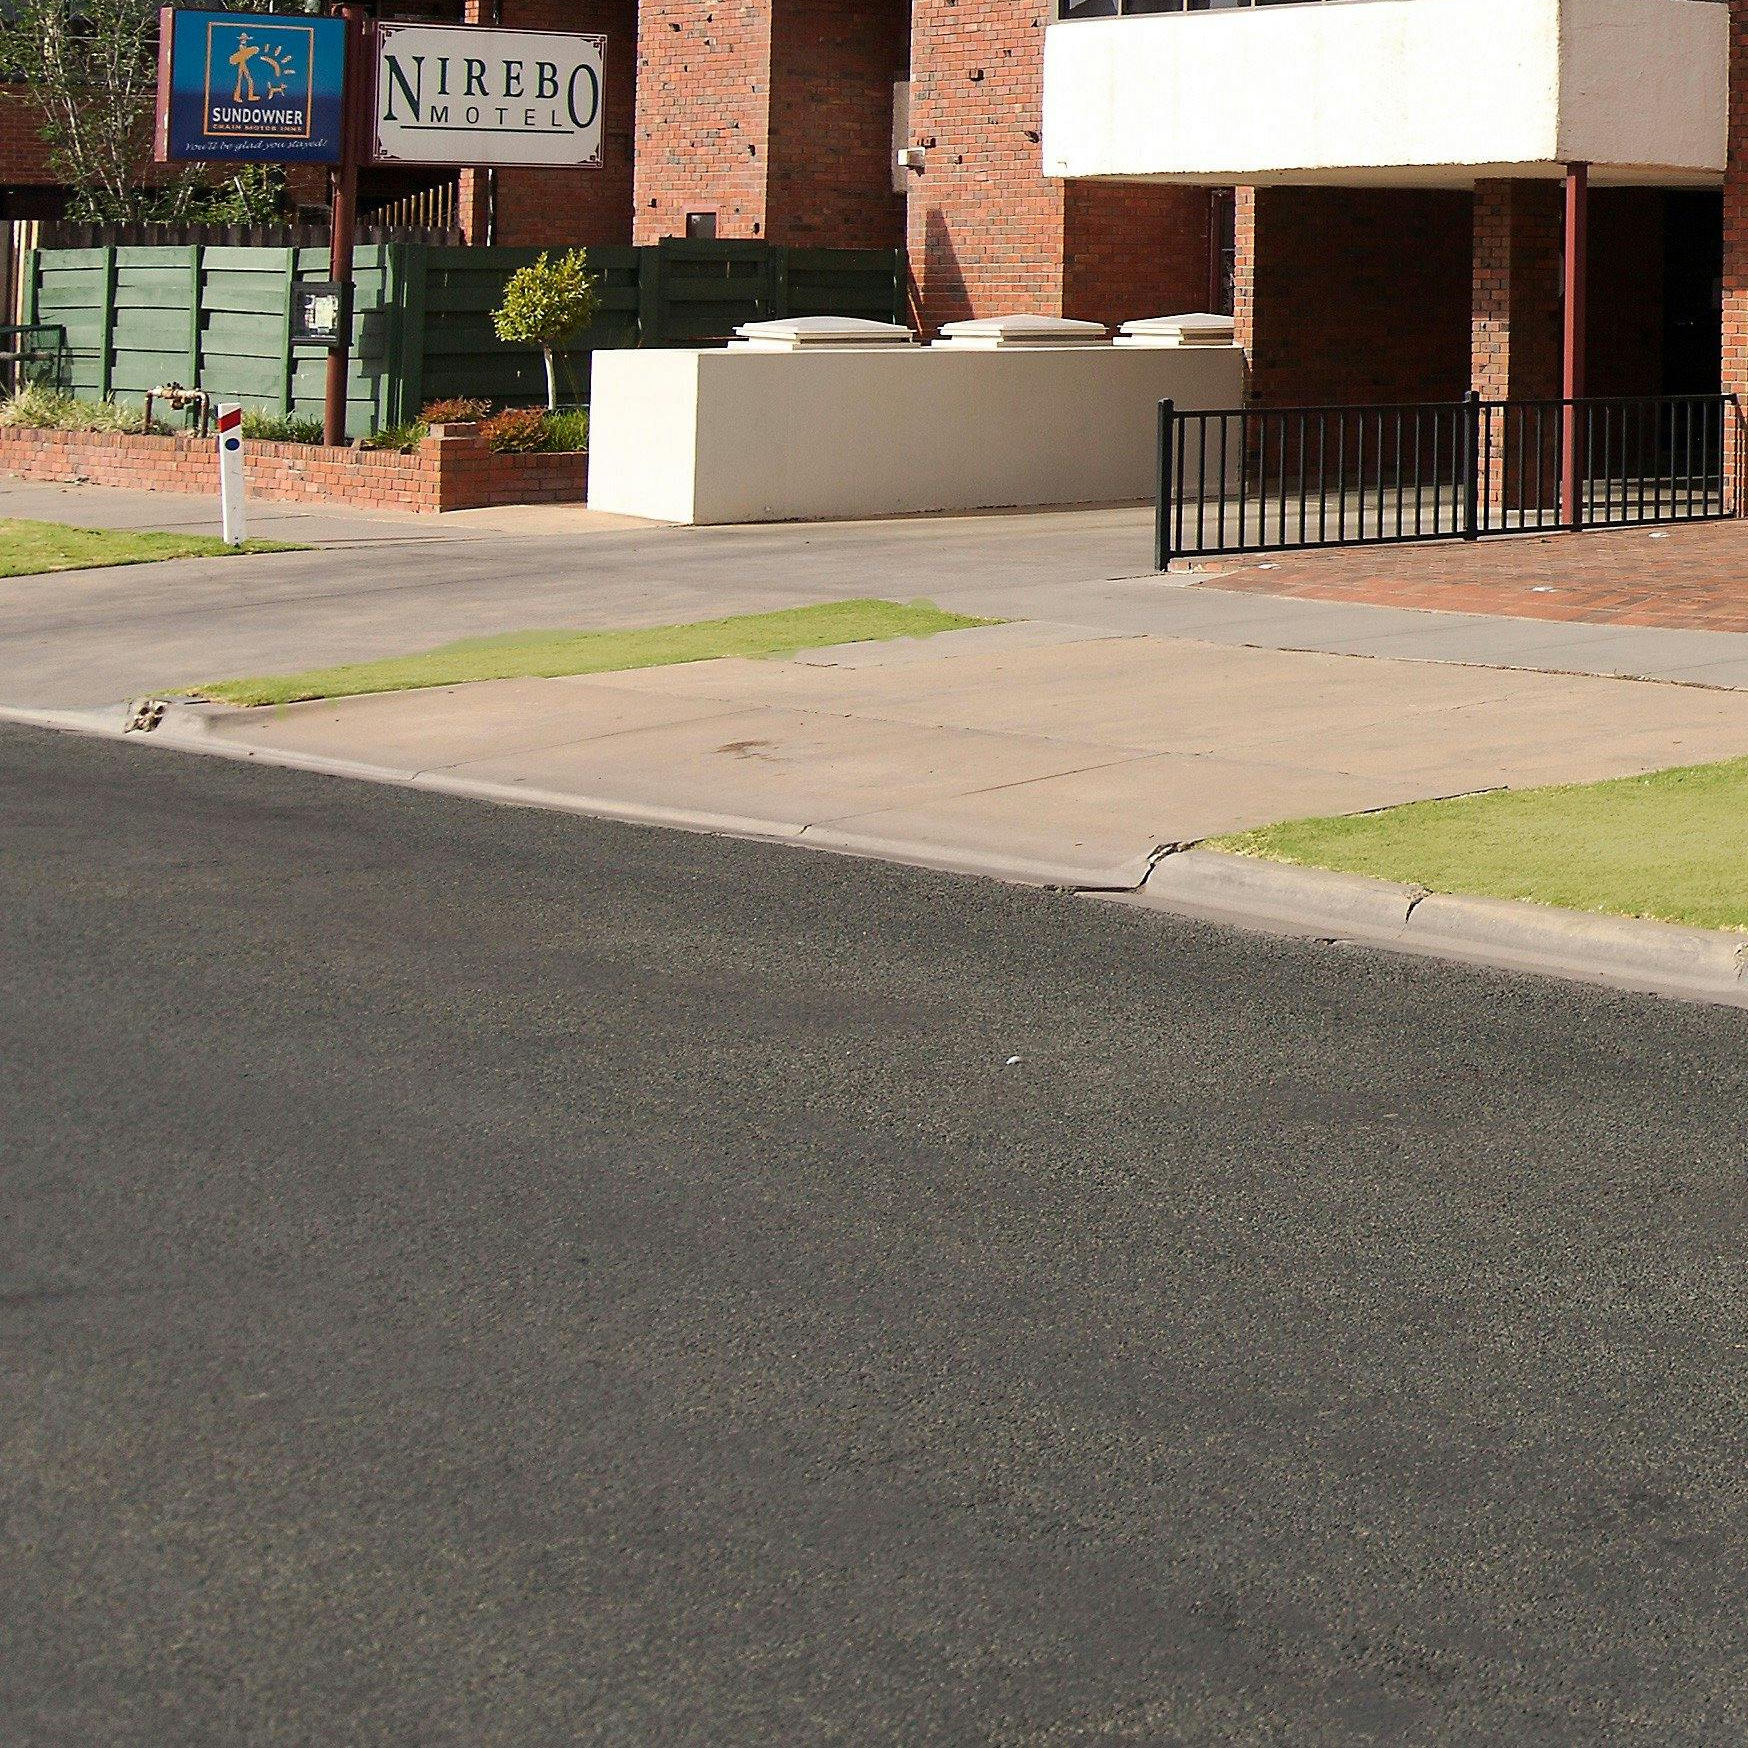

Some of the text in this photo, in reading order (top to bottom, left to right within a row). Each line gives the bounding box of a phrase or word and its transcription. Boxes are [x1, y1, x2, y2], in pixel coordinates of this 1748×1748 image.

[383, 55, 599, 128] NIREBO
[212, 107, 303, 125] SUNDOWNER
[430, 105, 561, 127] MOTEL
